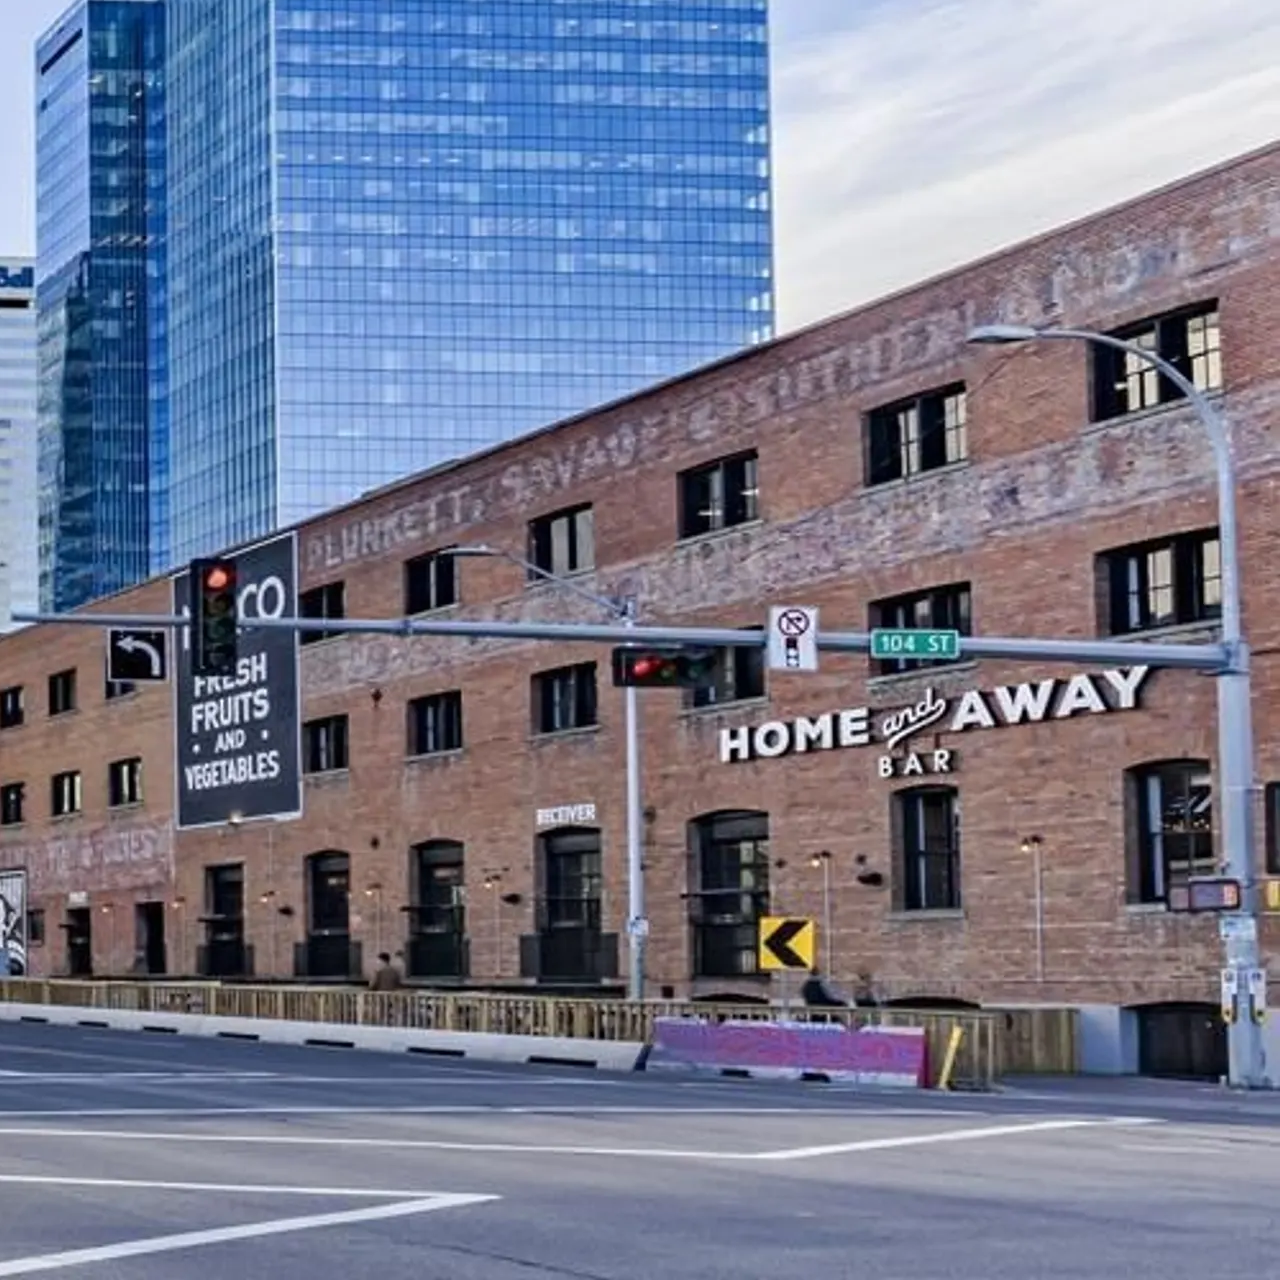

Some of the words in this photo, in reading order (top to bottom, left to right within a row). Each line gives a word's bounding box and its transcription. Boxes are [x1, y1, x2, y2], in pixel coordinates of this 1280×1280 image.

[880, 634, 916, 653] 104
[927, 634, 950, 653] ST
[191, 688, 270, 734] FRUITS
[719, 707, 872, 763] HOME
[882, 688, 946, 749] and
[949, 665, 1149, 731] AWAY
[214, 729, 247, 753] AND
[183, 749, 280, 791] VEGETABLES
[878, 749, 954, 778] BAR
